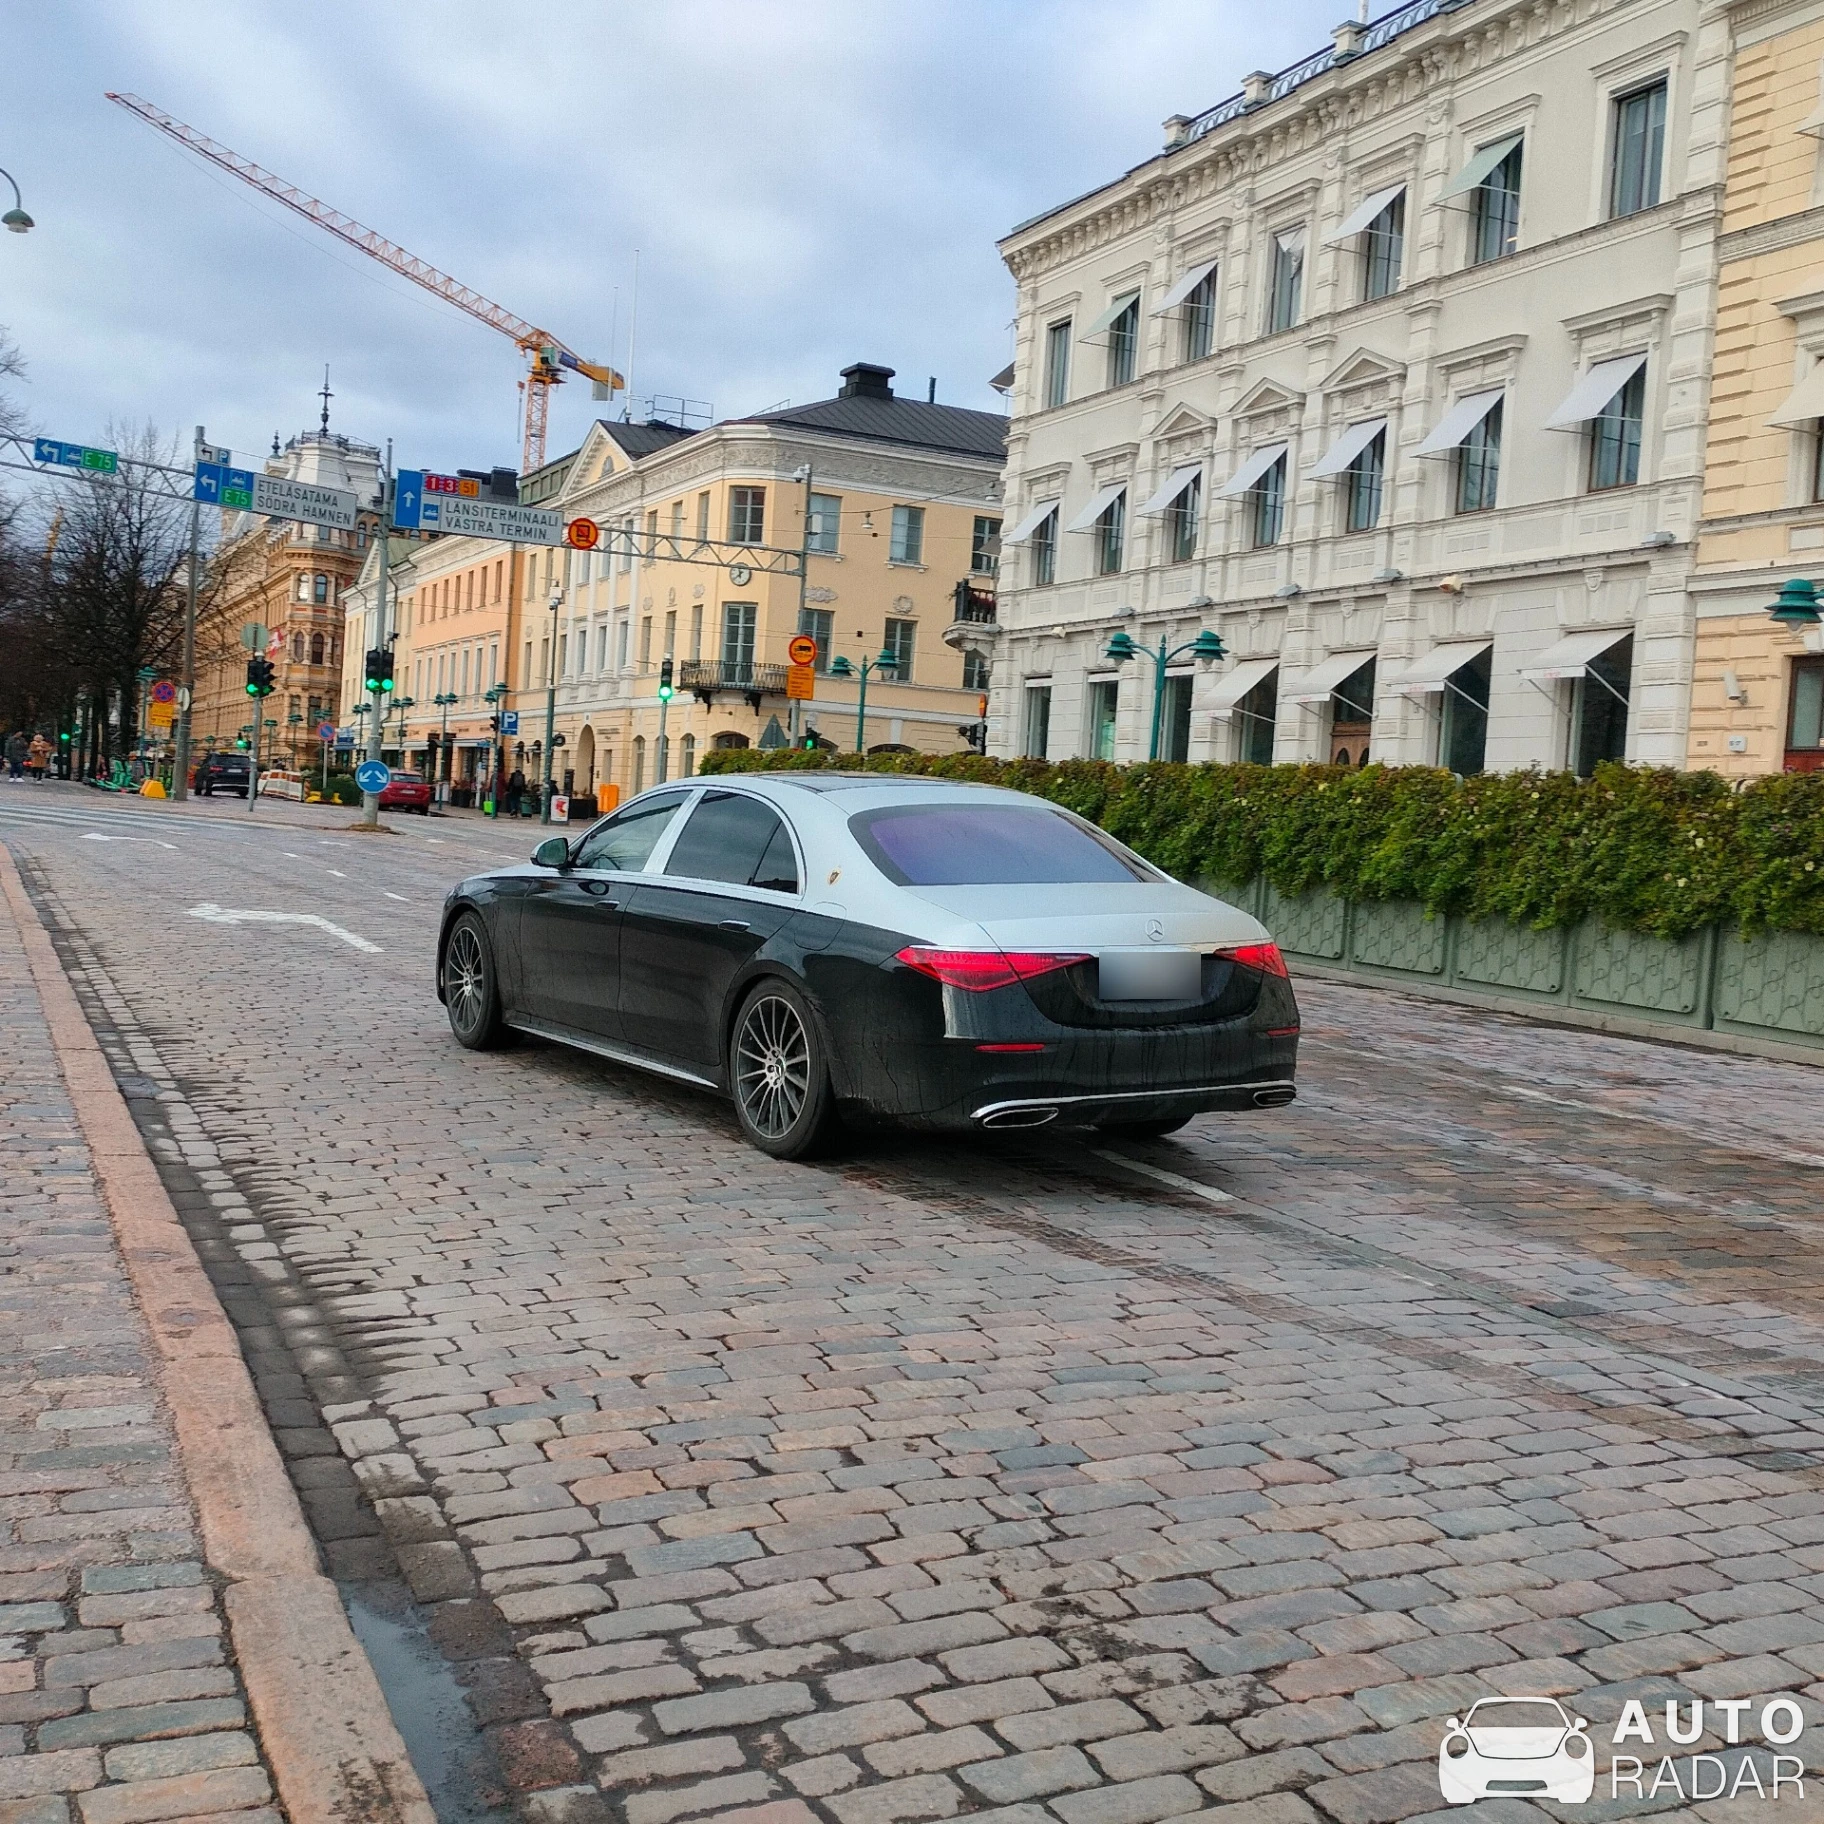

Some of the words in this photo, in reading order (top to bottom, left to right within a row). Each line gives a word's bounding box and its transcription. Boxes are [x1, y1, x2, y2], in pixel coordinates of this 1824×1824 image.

[84, 452, 92, 466] E
[97, 454, 112, 469] 75
[219, 450, 228, 463] P
[430, 477, 437, 489] 1
[447, 479, 454, 492] 3
[463, 482, 475, 495] 51
[224, 489, 232, 503] E
[235, 491, 248, 506] 75
[258, 479, 339, 508] ETELÄSATAMA
[257, 495, 297, 515] SÖDRA
[302, 505, 351, 525] HAMNEN
[445, 501, 558, 527] LÄNSITERMINAALI
[445, 516, 494, 534] VÄSTRA
[500, 522, 550, 541] TERMIN.
[503, 712, 517, 728] P
